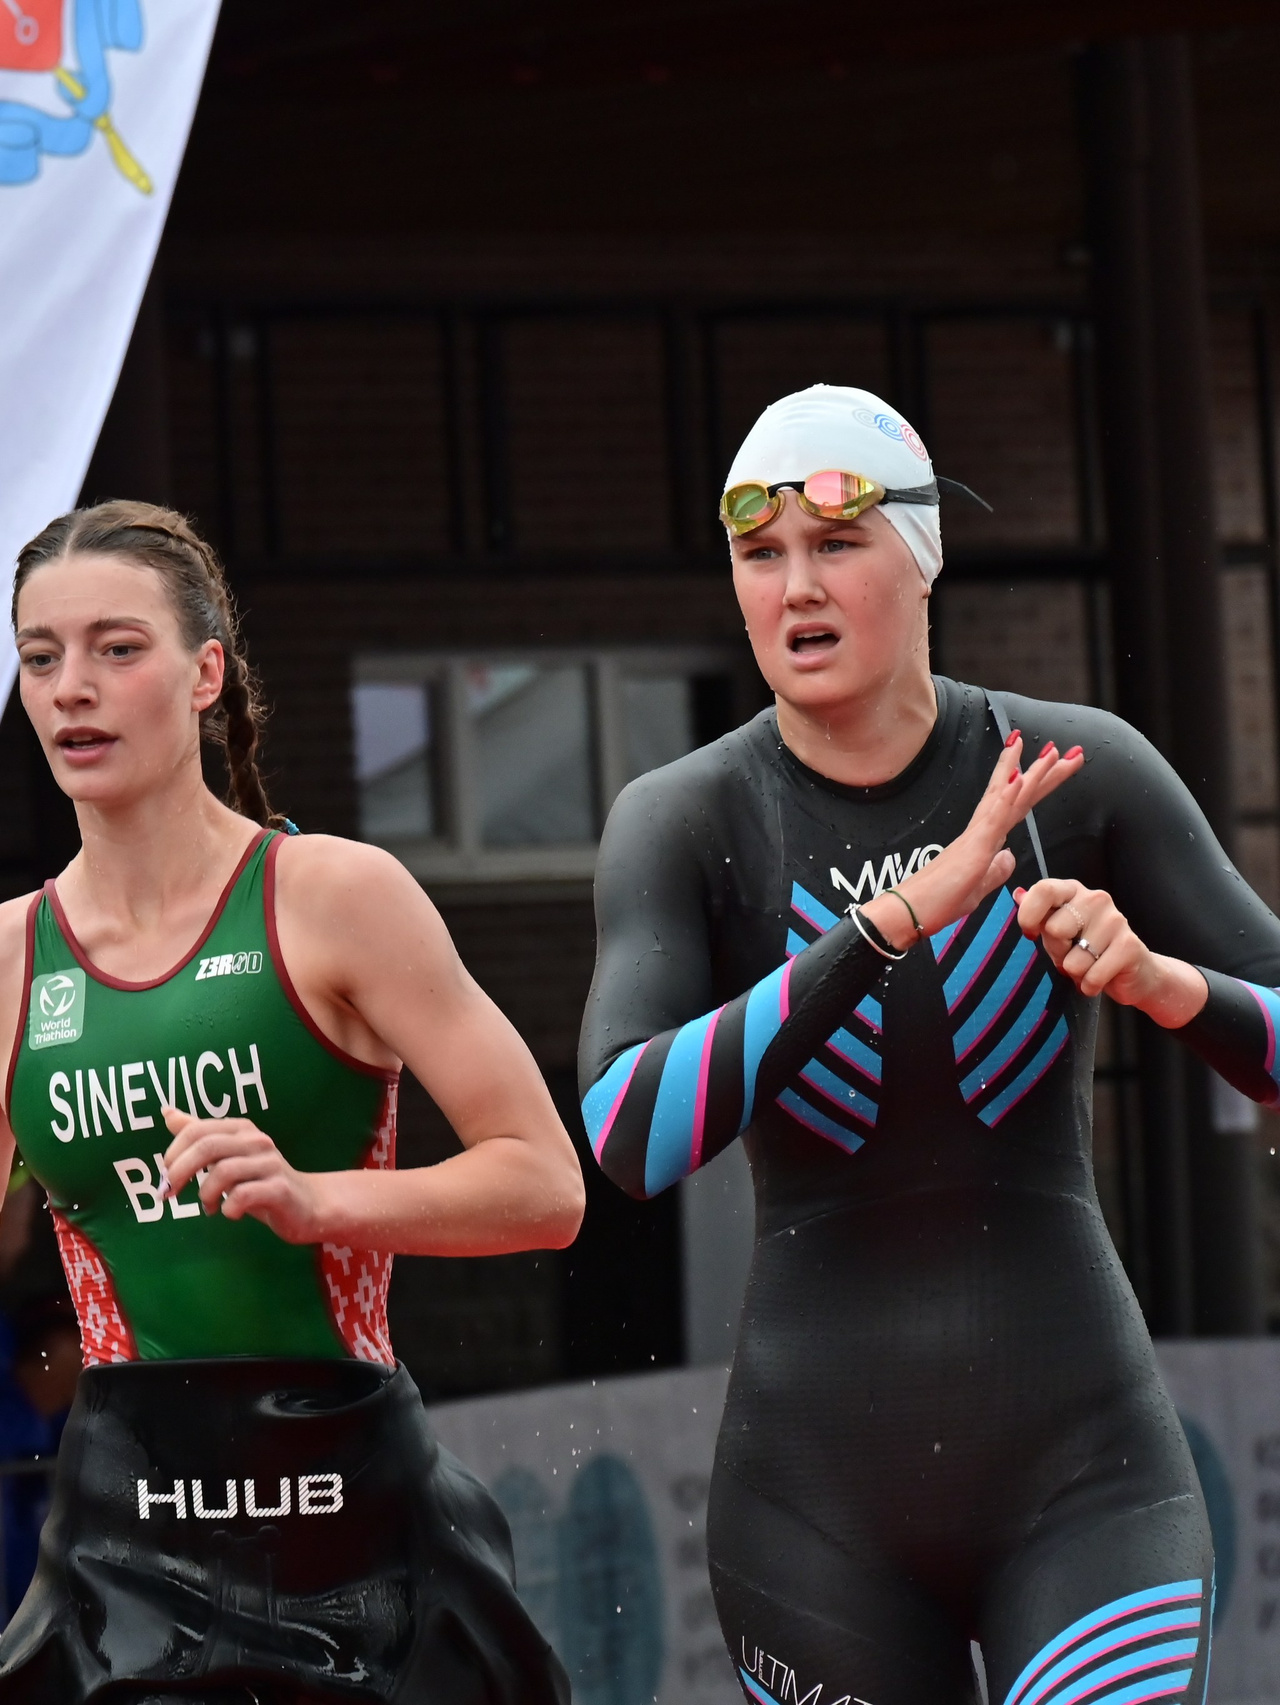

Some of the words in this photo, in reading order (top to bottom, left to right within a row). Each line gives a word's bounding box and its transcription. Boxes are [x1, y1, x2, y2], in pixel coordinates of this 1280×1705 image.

[34, 1028, 77, 1045] Triathlon
[40, 1017, 71, 1032] World
[49, 1043, 268, 1143] SINEVICH
[113, 1152, 227, 1223] BL
[137, 1473, 343, 1519] HUUB
[741, 1635, 873, 1705] ULTIM
